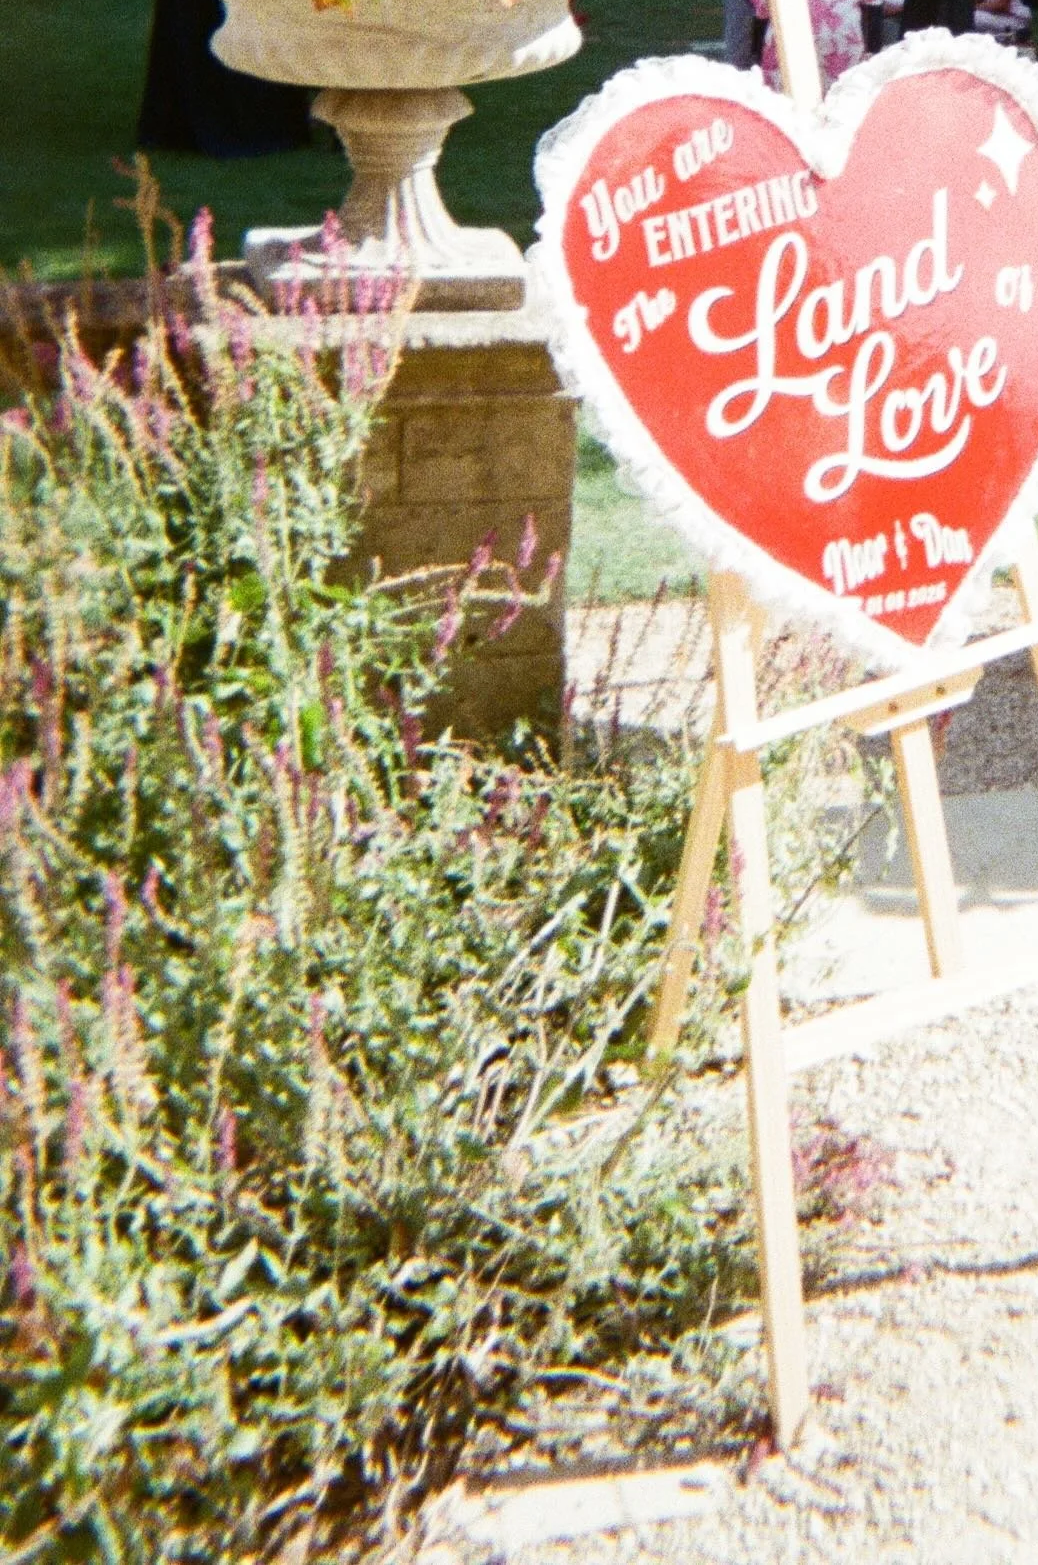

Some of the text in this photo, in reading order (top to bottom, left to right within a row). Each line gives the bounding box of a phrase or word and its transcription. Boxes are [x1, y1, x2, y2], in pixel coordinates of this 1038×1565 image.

[580, 117, 735, 262] You are
[641, 169, 819, 268] ENTERING
[612, 186, 1033, 440] The Land of
[803, 330, 1008, 503] Love
[910, 511, 974, 569] Dan
